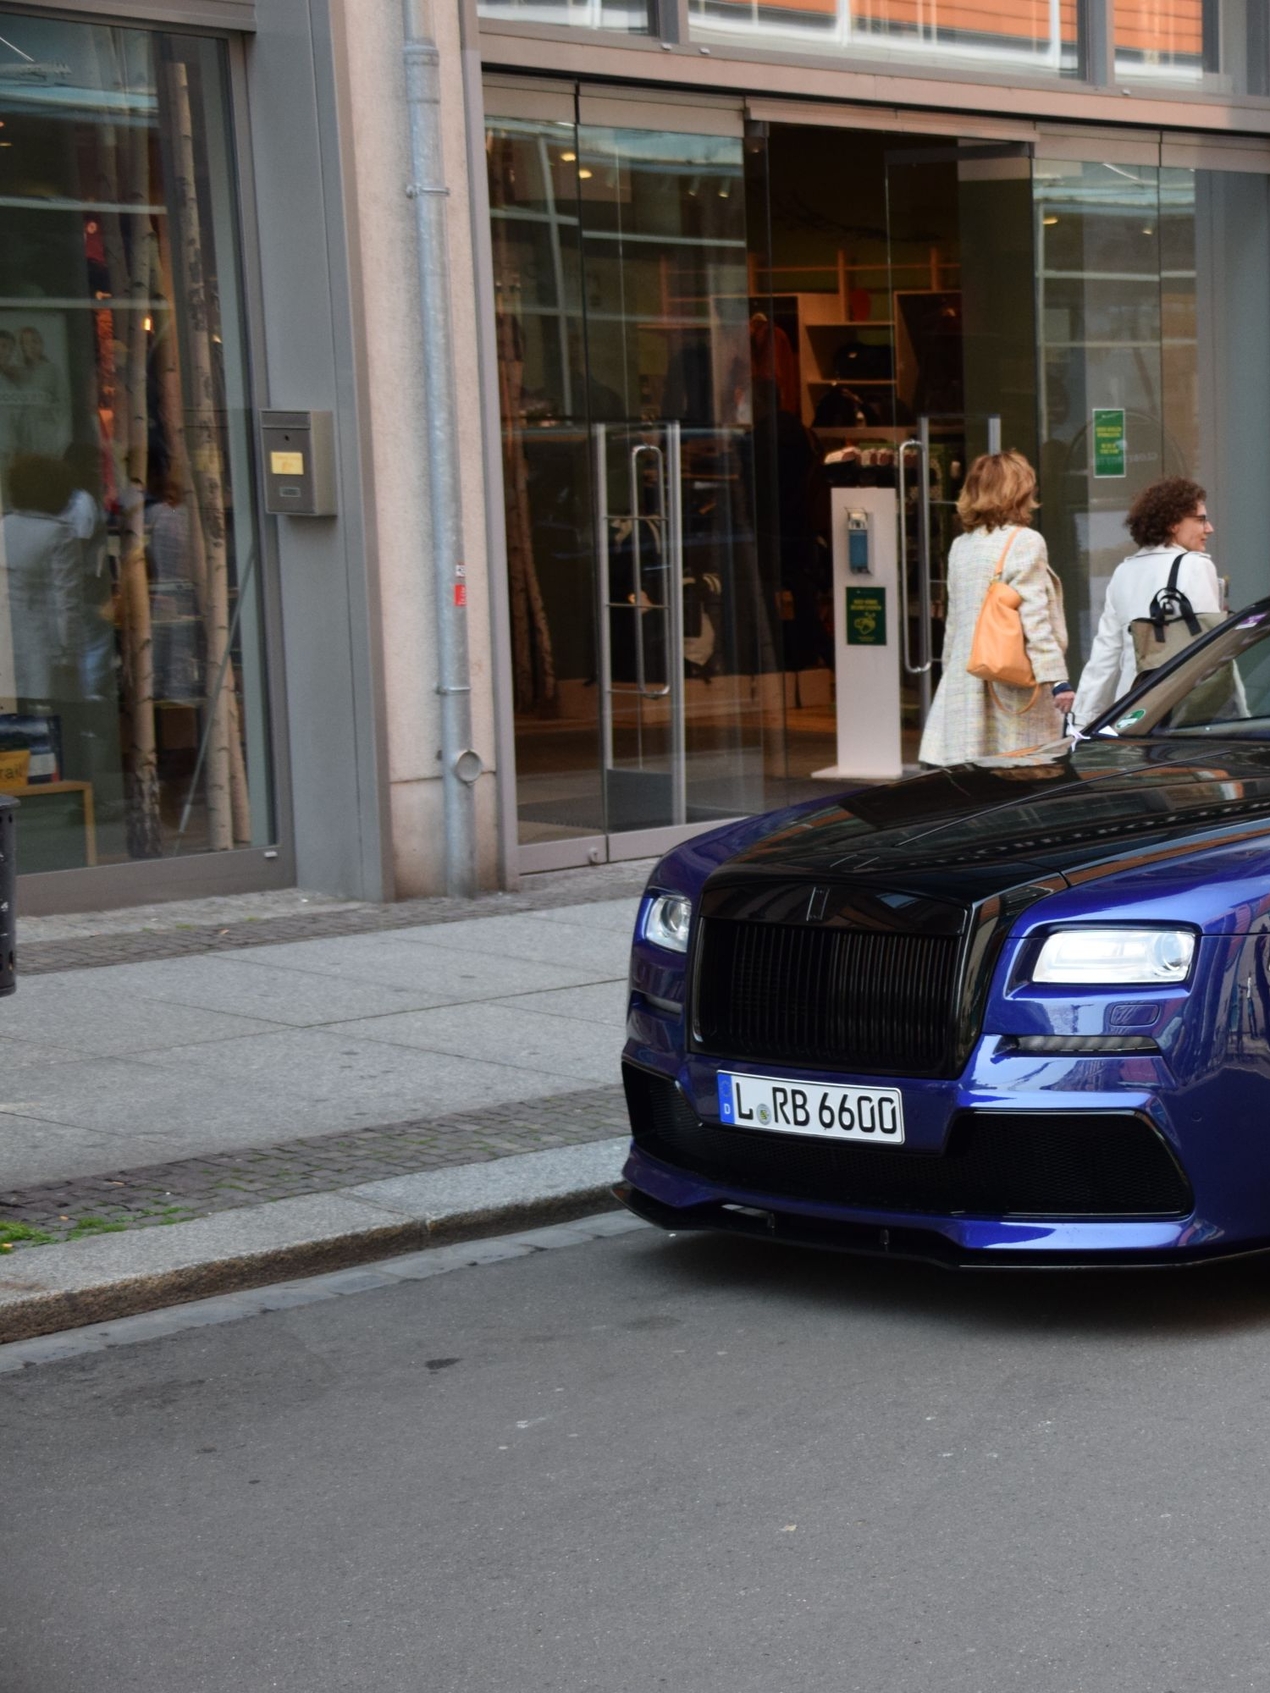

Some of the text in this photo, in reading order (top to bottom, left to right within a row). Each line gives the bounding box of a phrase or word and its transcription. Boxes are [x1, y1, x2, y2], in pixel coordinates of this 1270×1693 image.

[723, 1103, 731, 1115] D
[735, 1082, 897, 1134] L RB 6600
